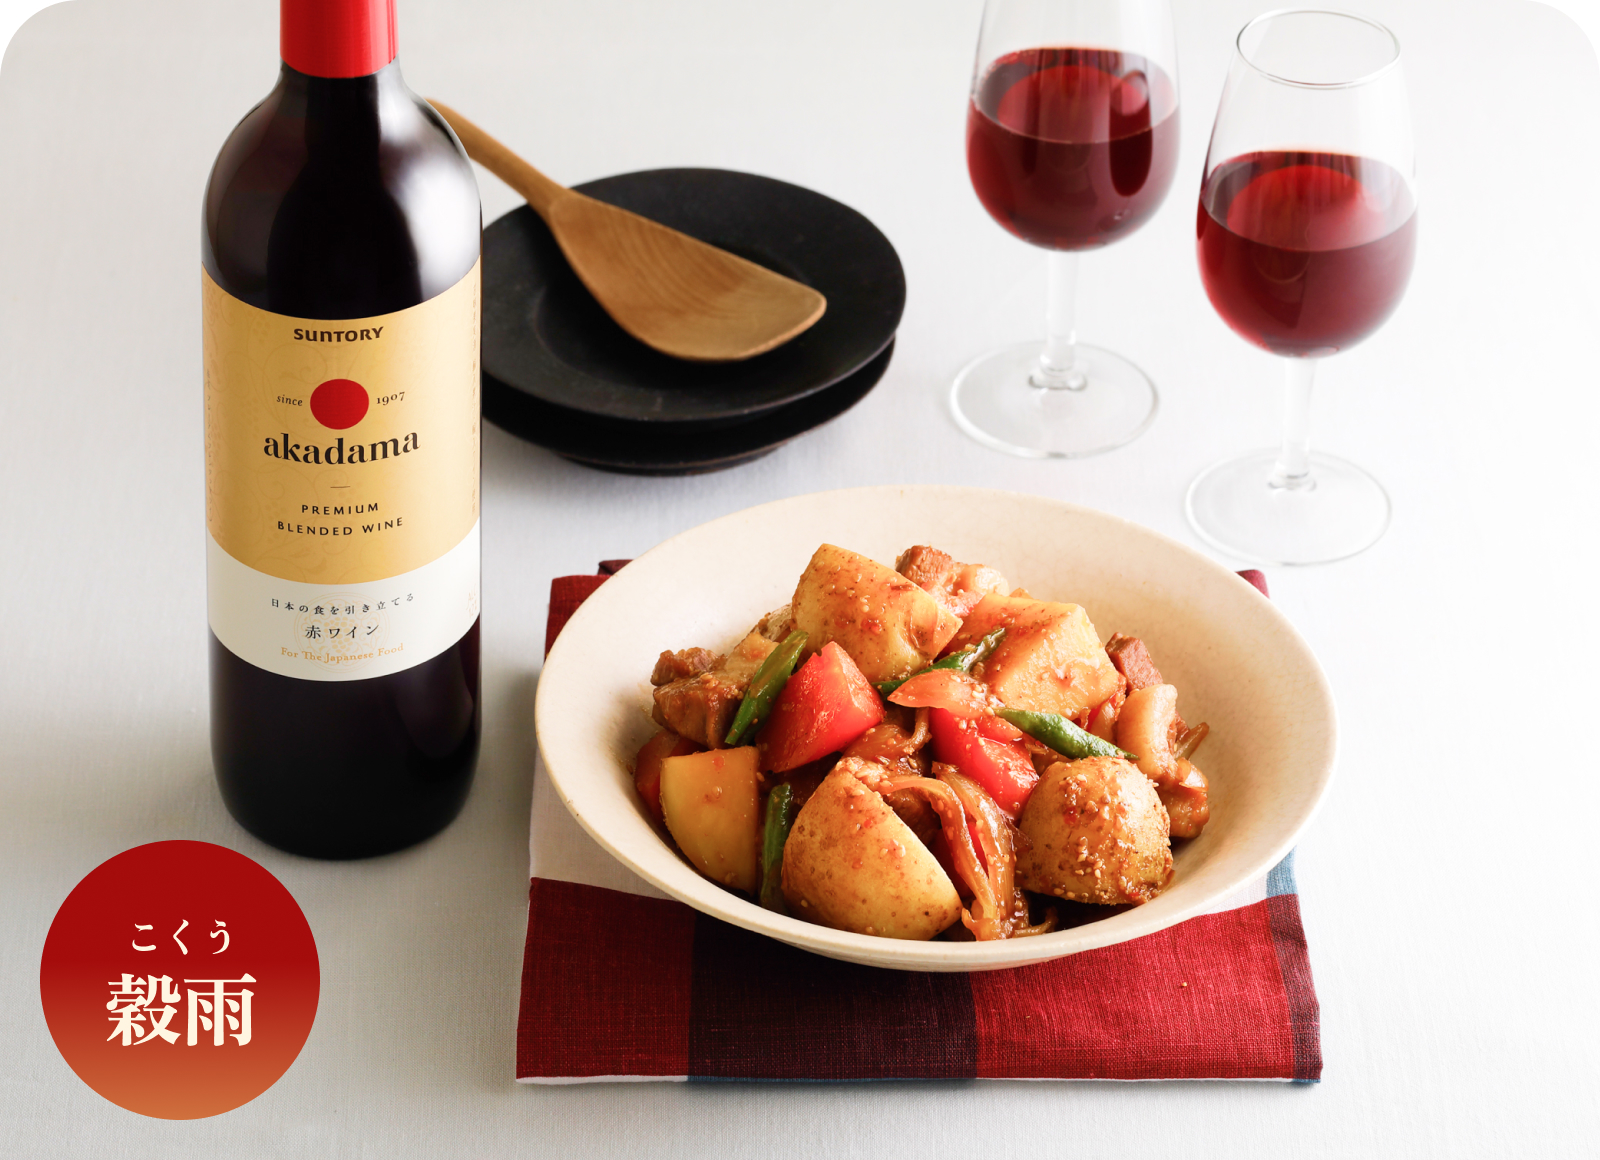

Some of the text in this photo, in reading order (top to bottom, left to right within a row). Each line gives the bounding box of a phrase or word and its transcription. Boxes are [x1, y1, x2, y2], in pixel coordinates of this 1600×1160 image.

[293, 326, 384, 342] SUNTORY
[276, 391, 406, 407] since 1907
[263, 432, 421, 465] akadama
[301, 502, 379, 515] PREMIUM
[277, 517, 404, 536] BLENDED WINE
[271, 593, 414, 615] 日本の食を引き立てる
[305, 624, 379, 640] 赤ワイン
[281, 643, 404, 664] For The Japanese Food
